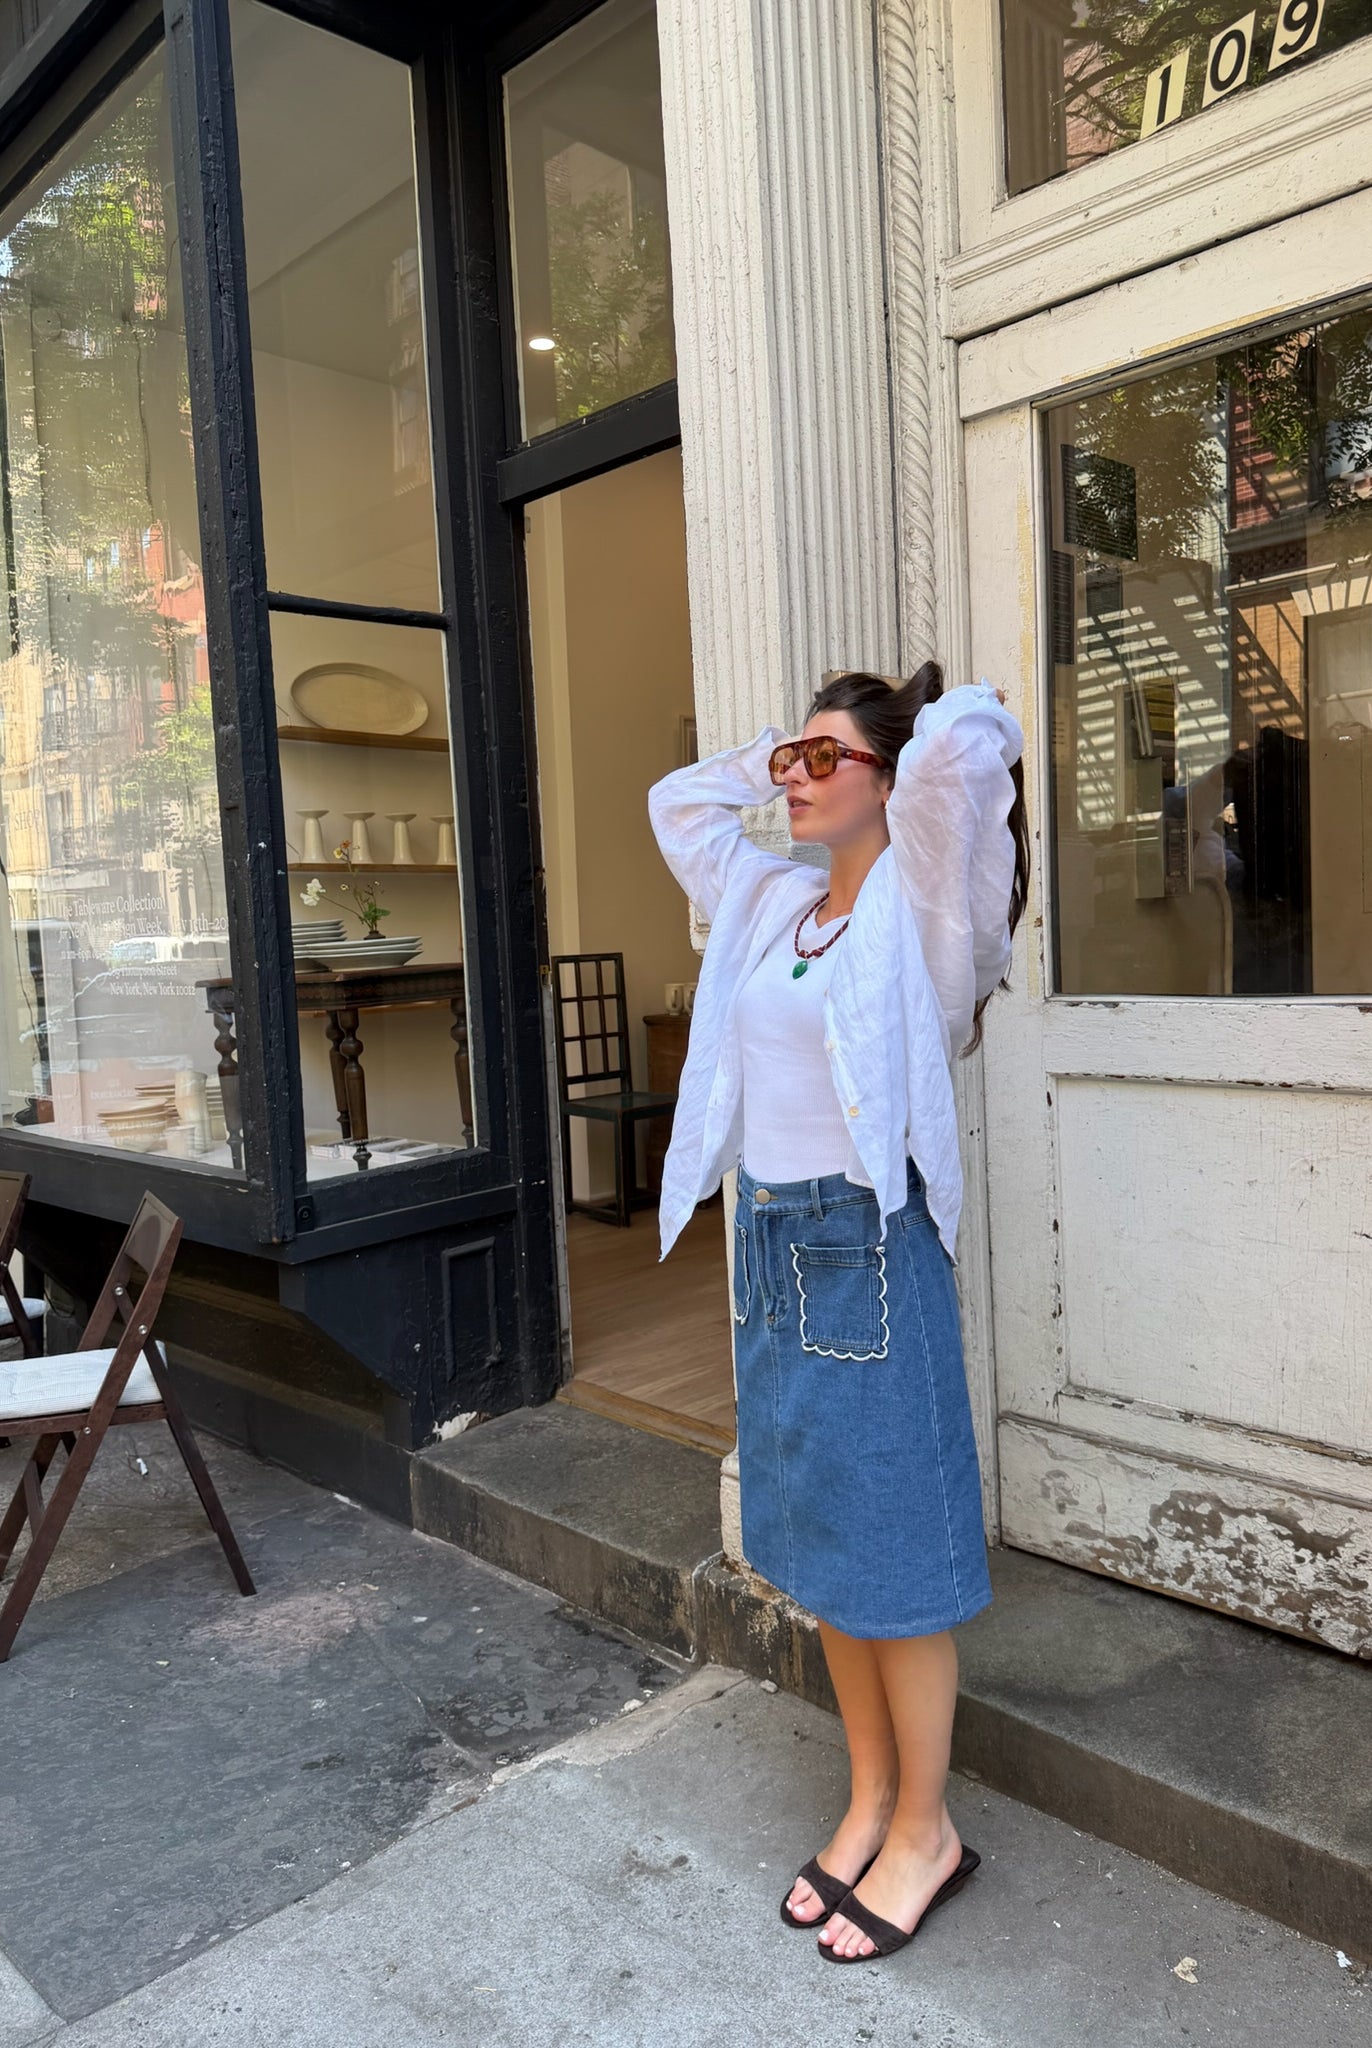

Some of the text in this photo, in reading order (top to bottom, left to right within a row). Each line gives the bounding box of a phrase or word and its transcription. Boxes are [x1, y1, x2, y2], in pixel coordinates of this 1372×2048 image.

[1156, 0, 1319, 127] 109
[73, 896, 116, 917] Tableware
[116, 891, 164, 913] Collection
